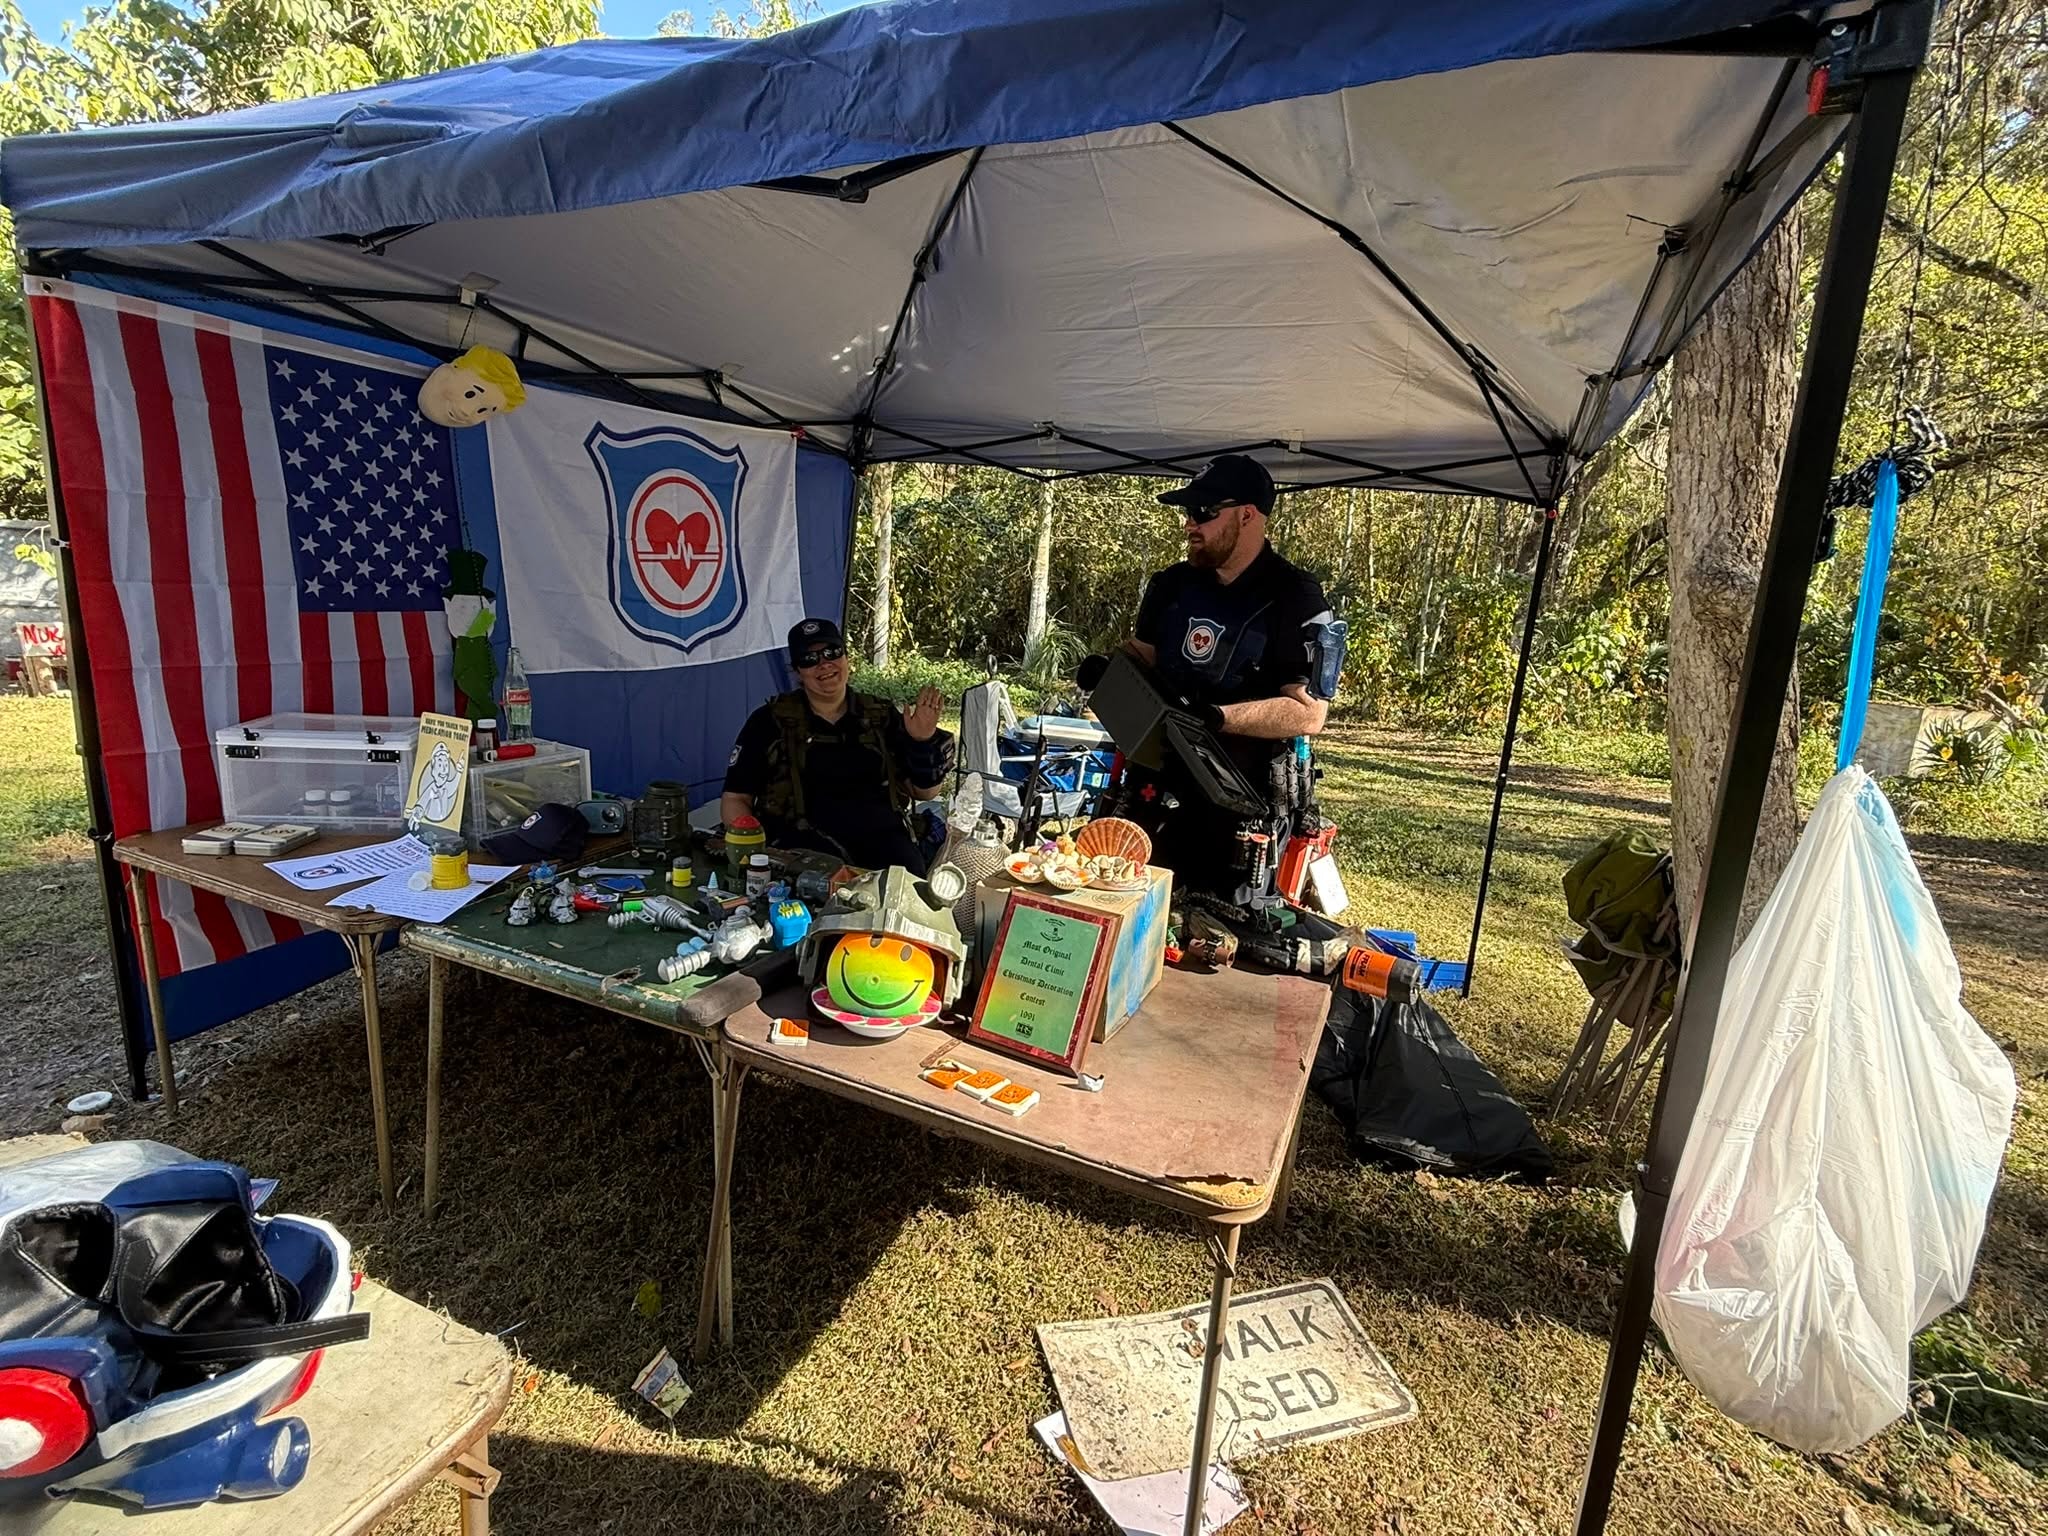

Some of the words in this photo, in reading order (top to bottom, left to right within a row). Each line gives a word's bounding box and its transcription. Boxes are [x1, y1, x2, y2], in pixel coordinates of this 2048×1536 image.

[1022, 940, 1042, 952] Most
[1043, 946, 1072, 961] Original
[1020, 955, 1044, 970] Dental
[1045, 964, 1065, 976] Clinic
[1358, 954, 1370, 977] FRAM
[1002, 968, 1036, 986] Christmas
[1037, 979, 1074, 997] Decoration
[1019, 991, 1046, 1006] Contest
[1020, 1009, 1036, 1021] 1991
